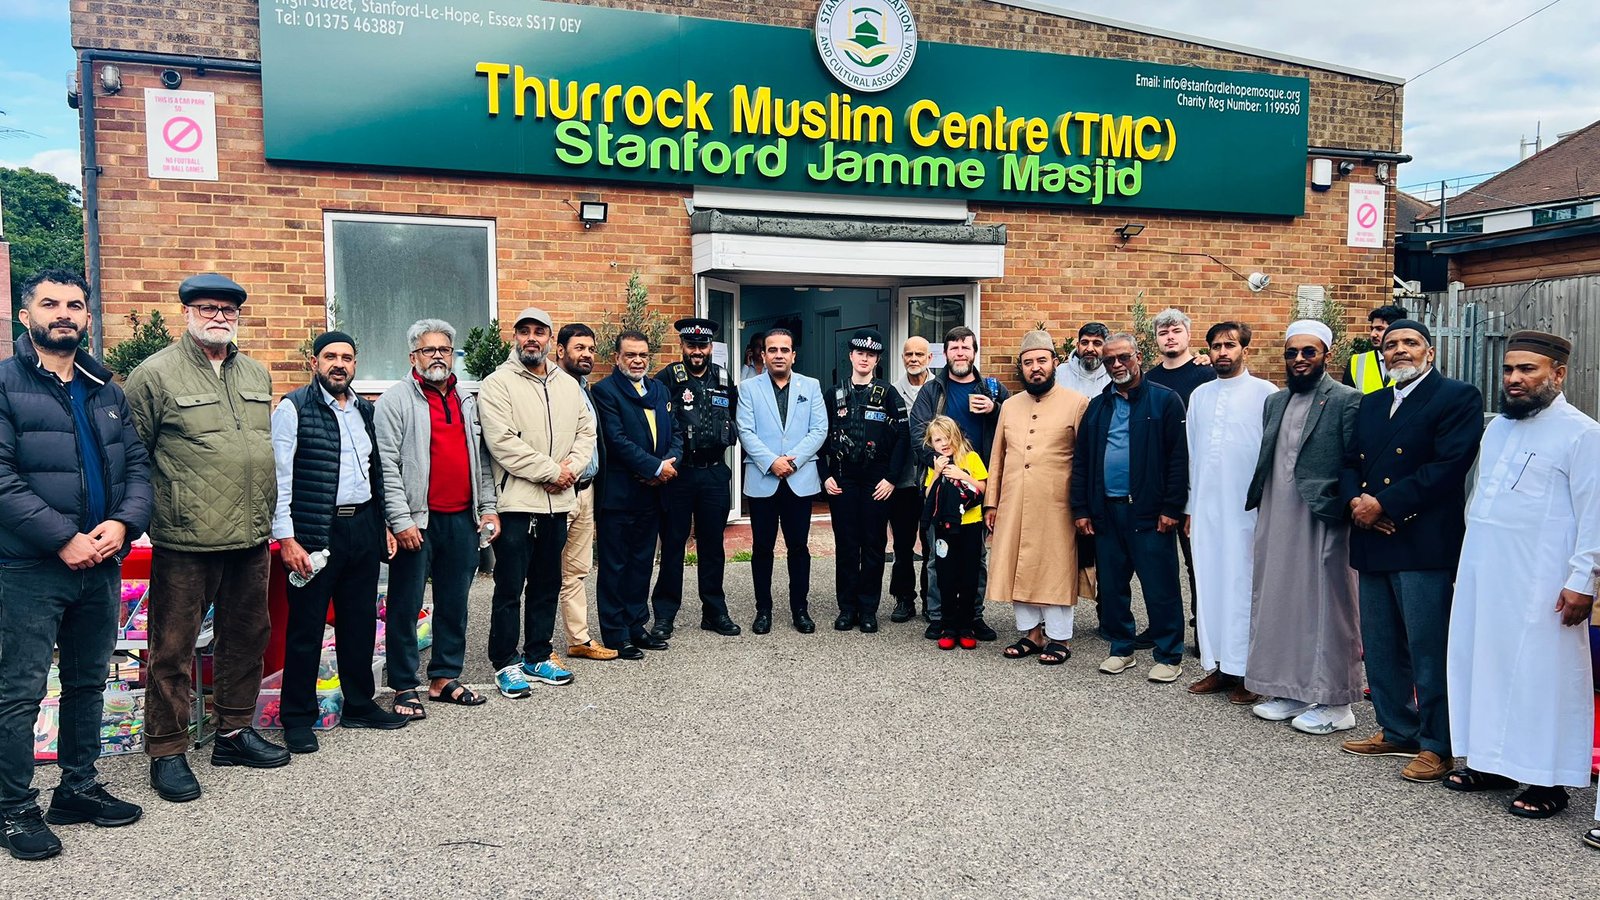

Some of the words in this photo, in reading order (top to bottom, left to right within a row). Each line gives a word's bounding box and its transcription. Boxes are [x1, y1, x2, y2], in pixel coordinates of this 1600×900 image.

[275, 9, 300, 25] Tel:
[305, 11, 349, 30] 01375
[353, 16, 405, 35] 463887
[362, 0, 483, 27] Stanford-Le-Hope,
[488, 11, 523, 28] Essex
[526, 14, 556, 31] SS17
[559, 17, 582, 33] 0EY
[820, 36, 832, 57] AND
[829, 58, 870, 87] CULTURAL
[871, 42, 914, 87] ASSOCIATION
[1135, 73, 1161, 88] Email:
[1162, 76, 1301, 102] info@stanfordlehopemosque.org
[1177, 93, 1207, 110] Charity
[1208, 96, 1225, 112] Reg
[1226, 98, 1262, 112] Number:
[1264, 102, 1300, 115] 1199590
[474, 61, 714, 131] Thurrock
[731, 84, 893, 144] Muslim
[908, 99, 1049, 153] Centre
[1058, 111, 1177, 161] (TMC)
[554, 120, 788, 178] Stanford
[807, 141, 986, 189] Jamme
[1002, 153, 1142, 205] Masjid
